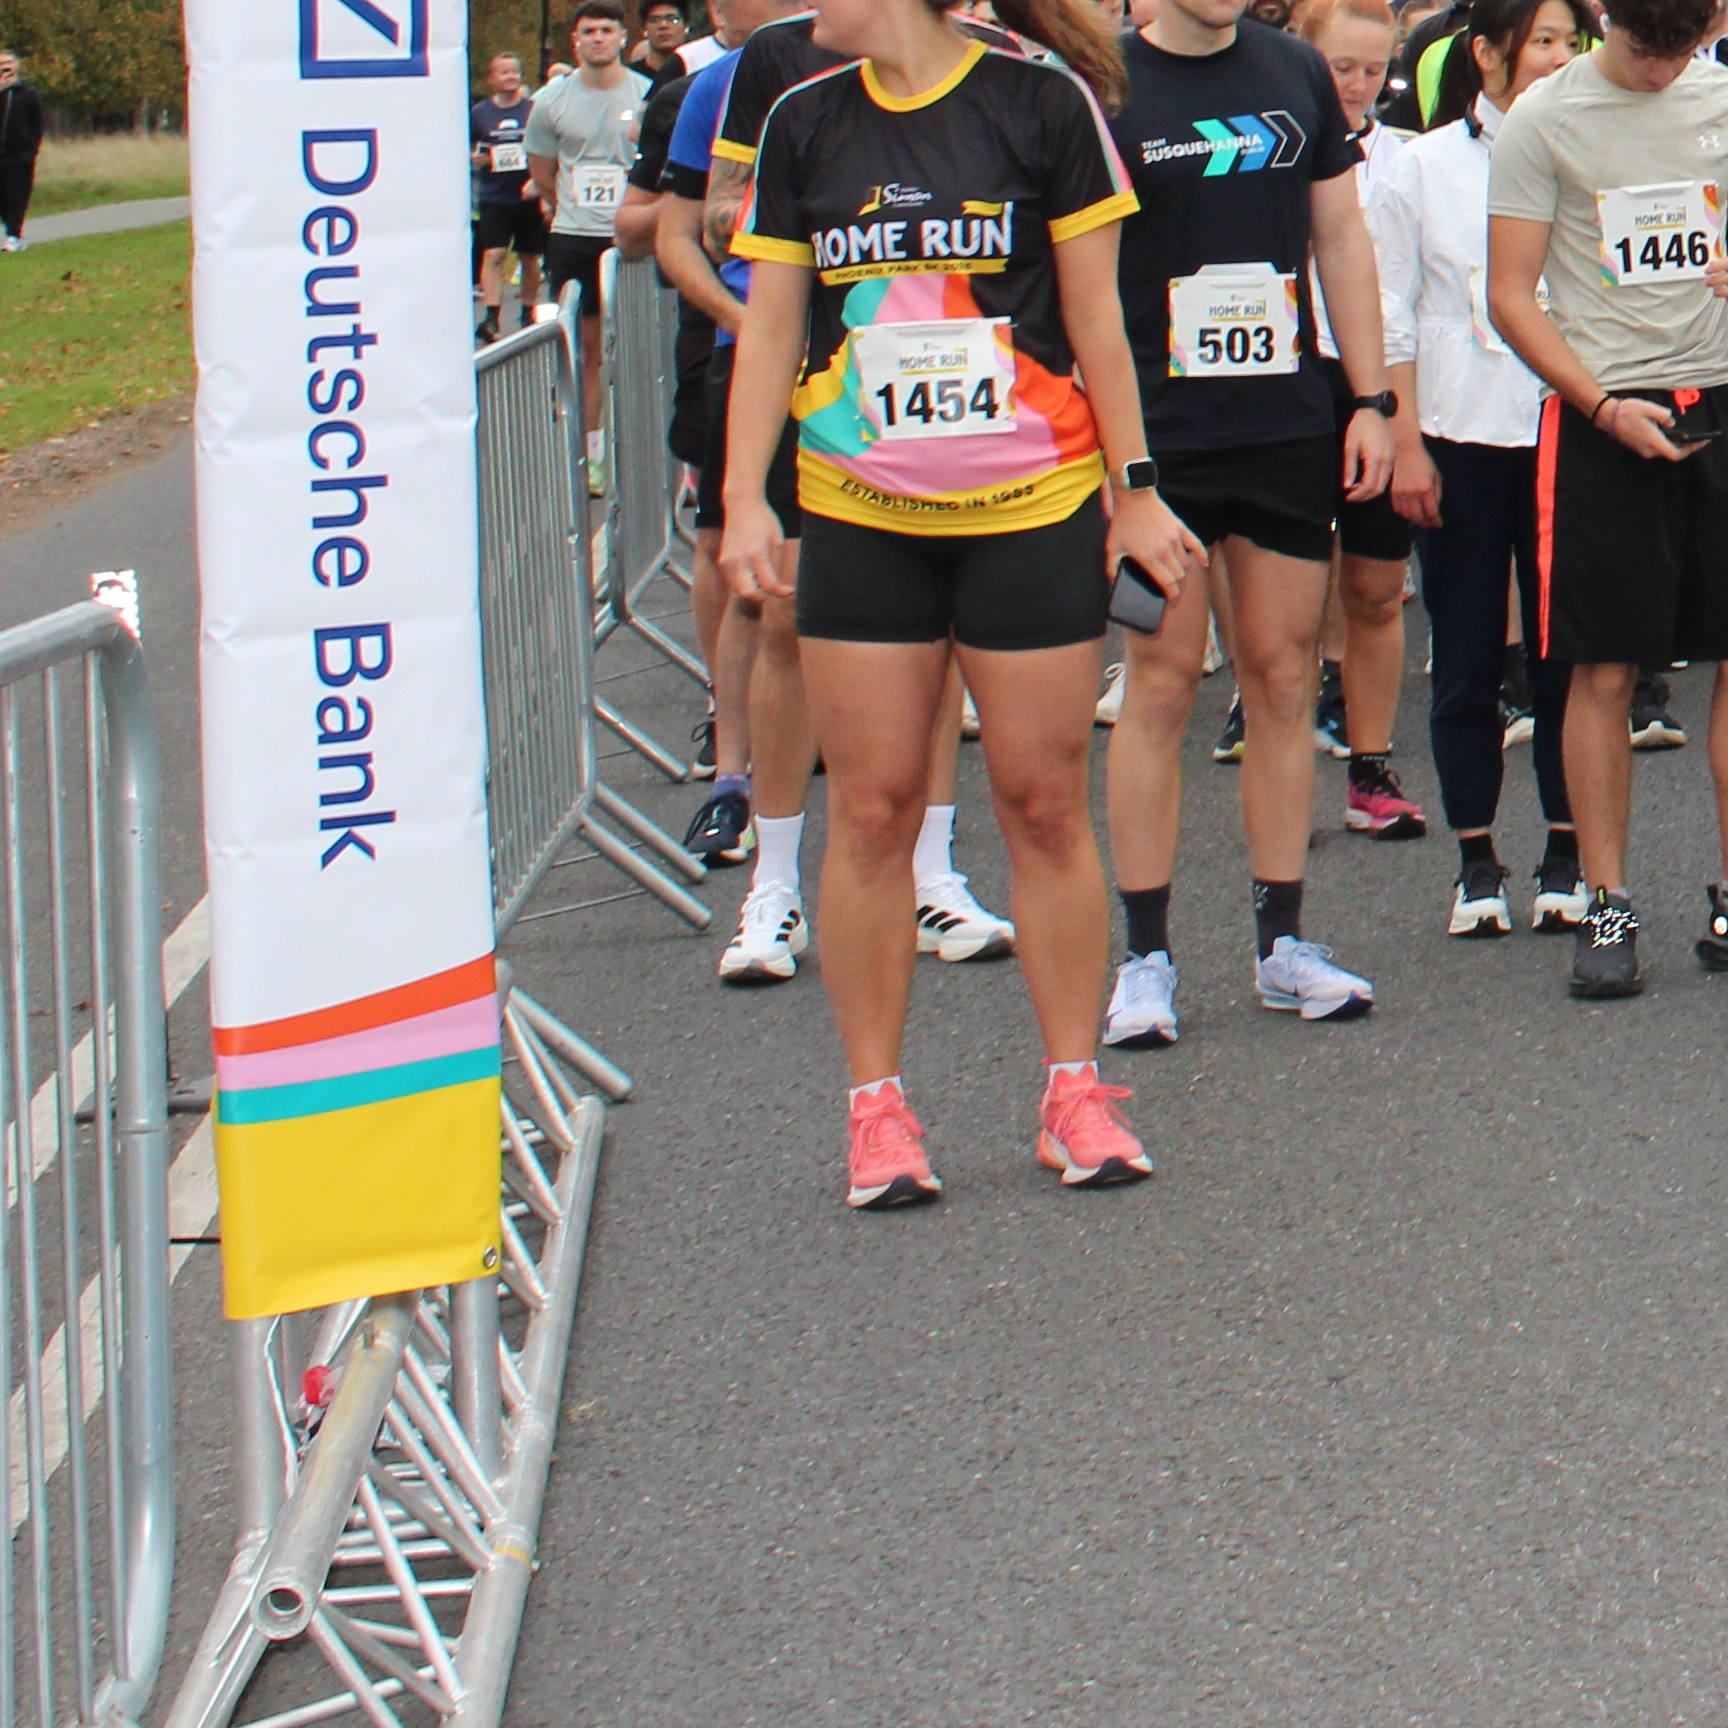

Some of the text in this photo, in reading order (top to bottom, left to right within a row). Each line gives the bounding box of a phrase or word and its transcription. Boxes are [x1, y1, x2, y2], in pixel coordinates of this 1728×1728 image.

[1142, 133, 1264, 165] SUSQUEHANNA
[583, 185, 615, 202] 121
[922, 201, 1014, 258] RUN
[1635, 206, 1687, 226] HOME RUN
[1614, 230, 1710, 274] 1446
[1209, 299, 1267, 317] HOME RUN
[898, 347, 968, 370] HOME RUN
[1197, 325, 1275, 364] 503
[876, 376, 1000, 426] 1454
[300, 127, 399, 873] Deutsche Bank
[840, 478, 960, 511] ESTABLISHED
[965, 498, 986, 509] IN
